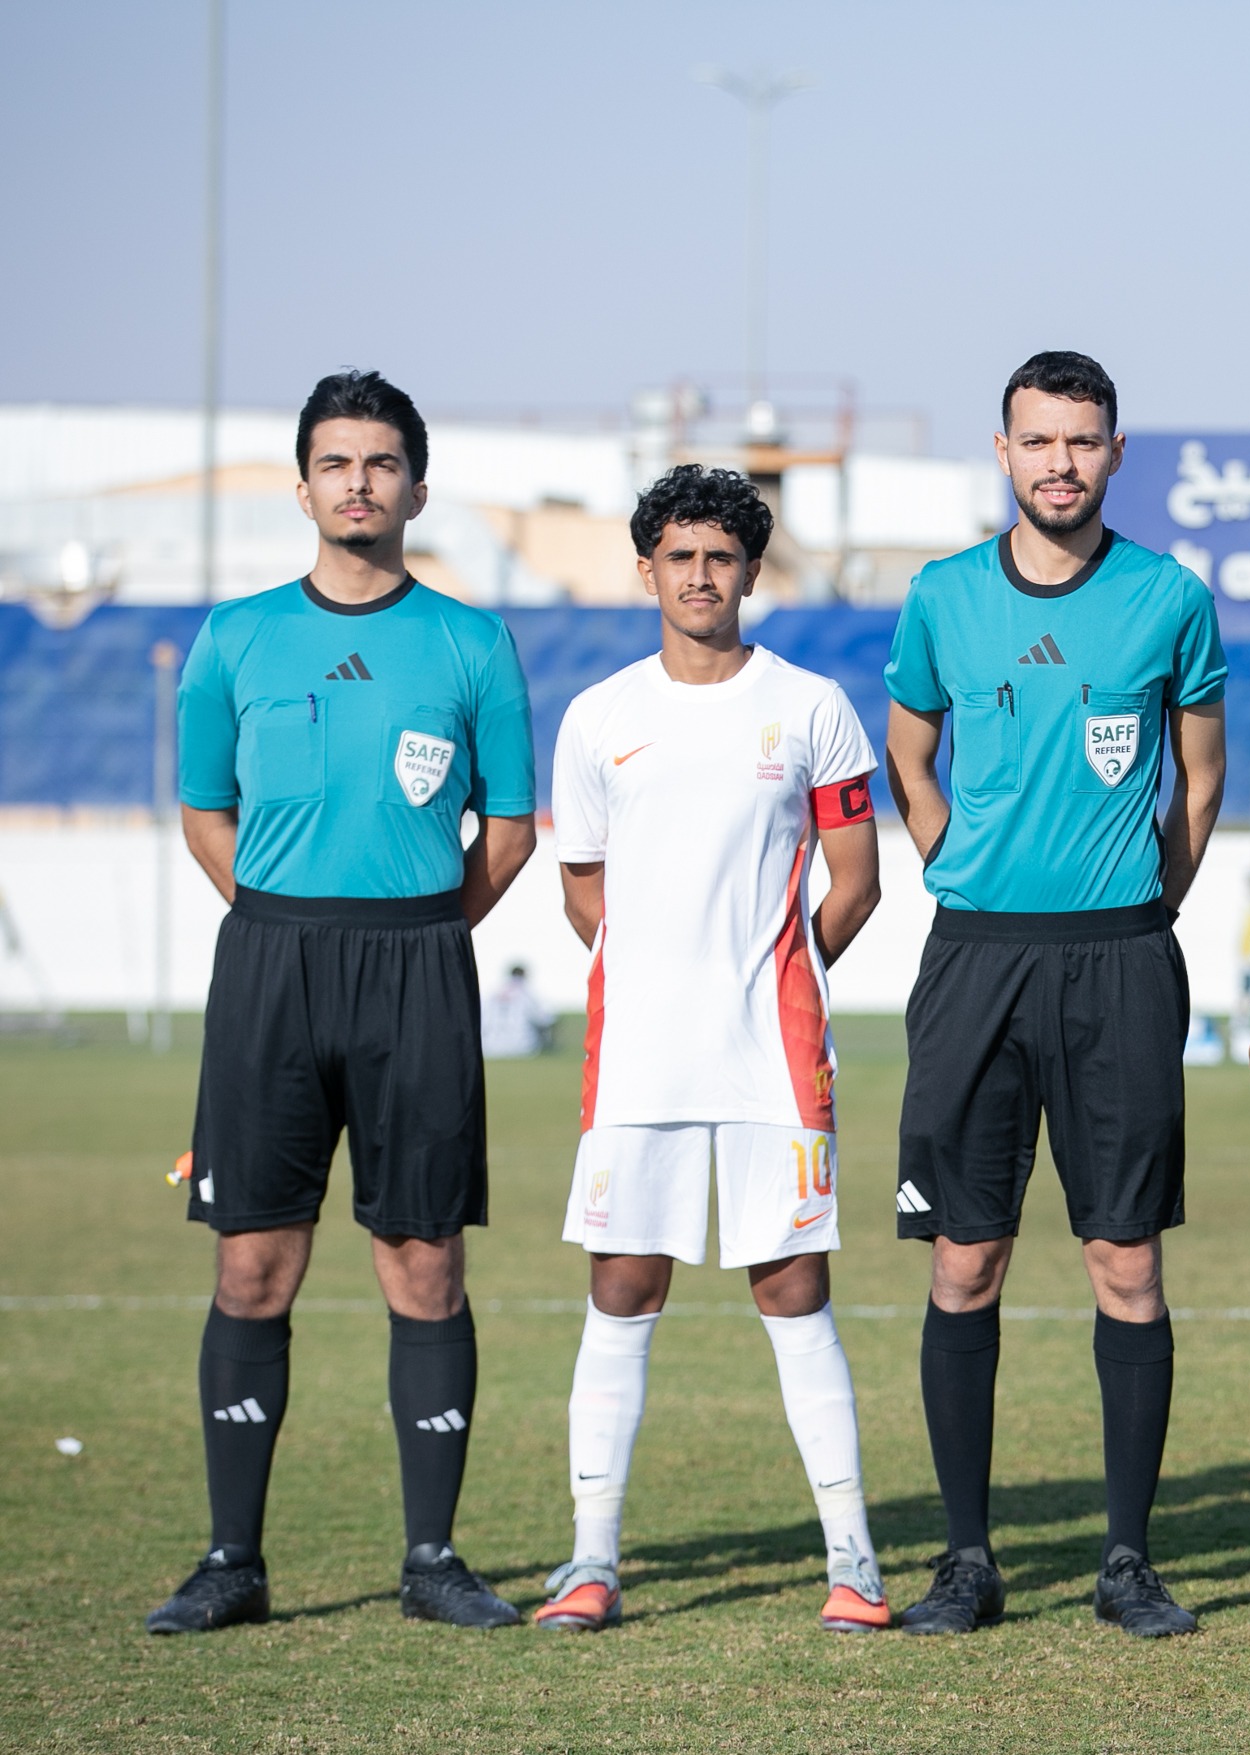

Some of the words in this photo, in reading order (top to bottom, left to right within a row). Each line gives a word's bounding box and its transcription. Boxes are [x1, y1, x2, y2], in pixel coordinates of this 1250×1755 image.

[1091, 723, 1136, 744] SAFF
[404, 741, 450, 765] SAFF
[1095, 745, 1132, 755] REFEREE
[405, 761, 443, 778] REFEREE
[839, 779, 869, 819] C
[791, 1135, 832, 1200] 10
